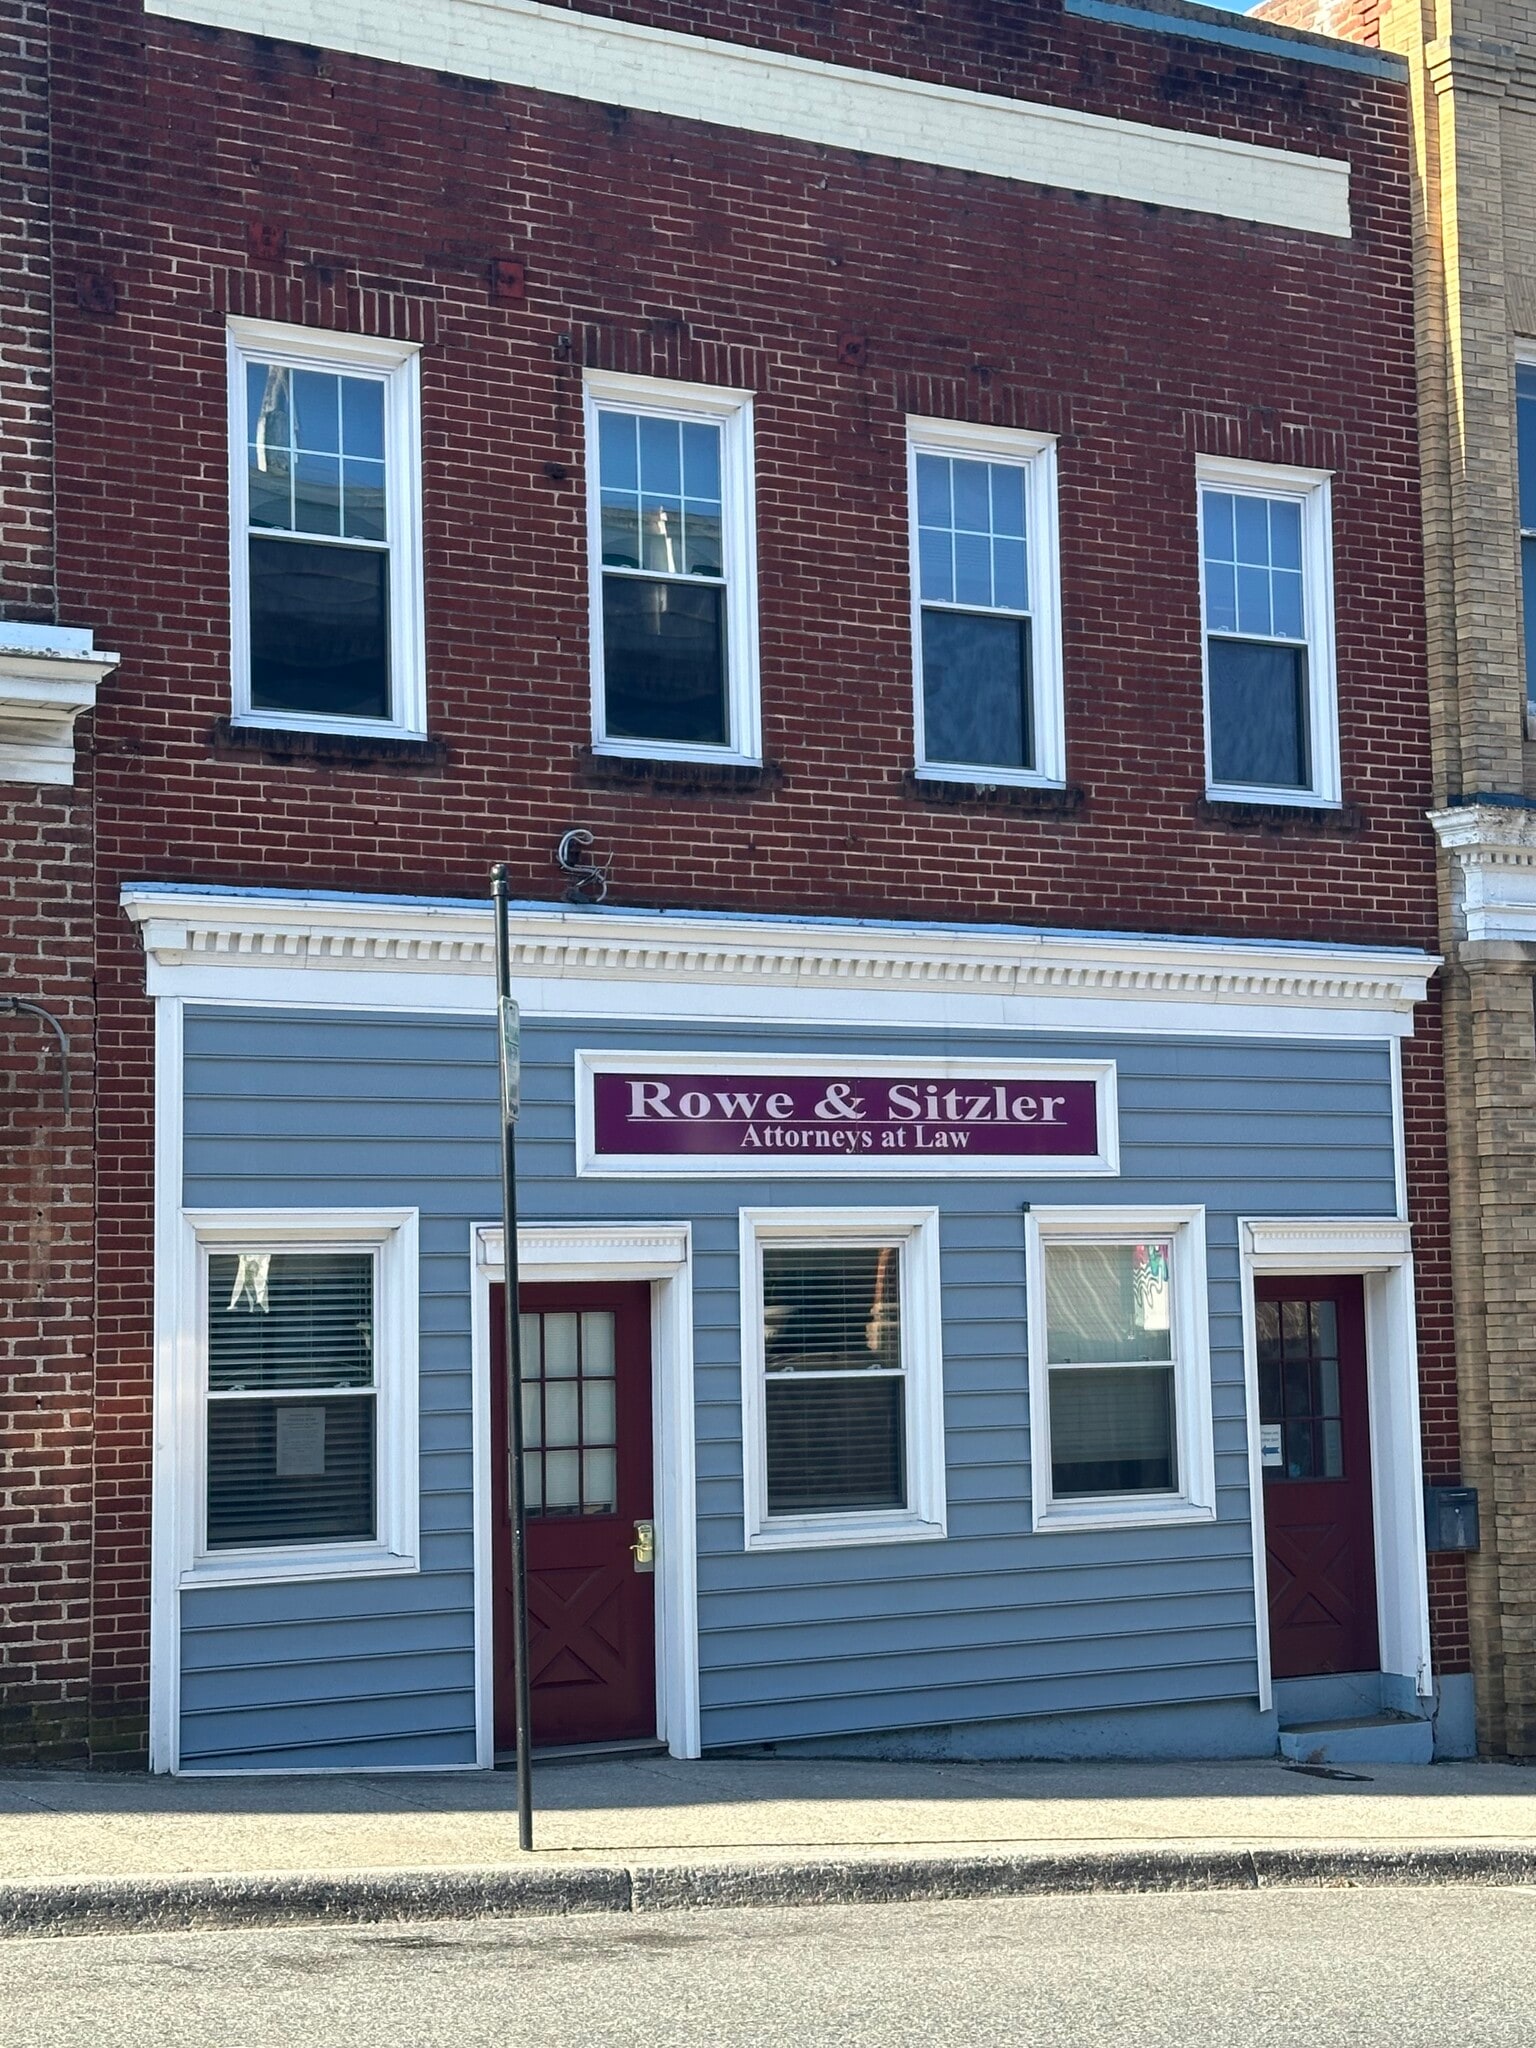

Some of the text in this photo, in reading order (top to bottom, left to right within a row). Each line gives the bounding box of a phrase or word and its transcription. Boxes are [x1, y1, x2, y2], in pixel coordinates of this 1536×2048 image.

[624, 1081, 1066, 1121] Rowe & Sitzler
[740, 1124, 971, 1154] Attorneys at Law
